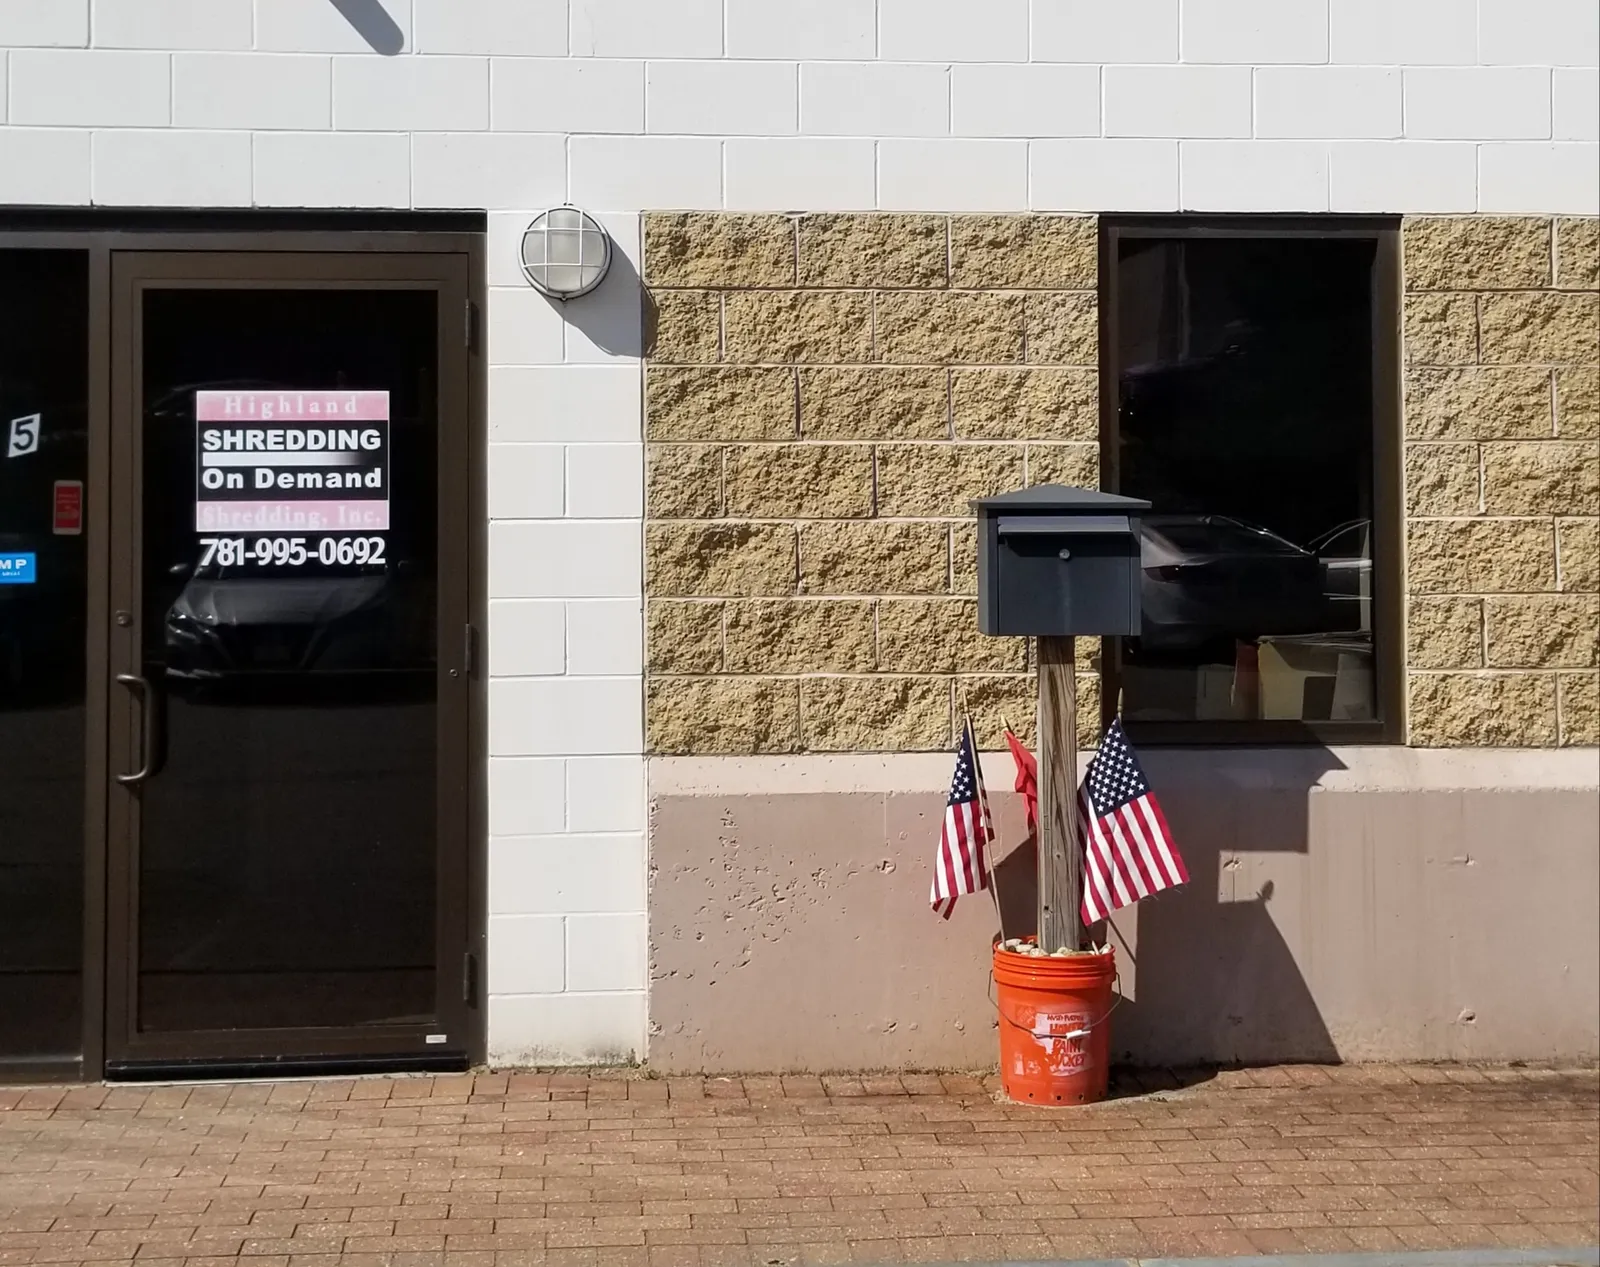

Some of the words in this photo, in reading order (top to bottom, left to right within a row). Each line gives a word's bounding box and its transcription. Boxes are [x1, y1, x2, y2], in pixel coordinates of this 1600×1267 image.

[224, 396, 357, 418] Highland
[13, 418, 34, 451] 5
[203, 429, 381, 450] SHREDDING
[202, 468, 244, 489] On
[255, 468, 381, 488] Demand
[203, 505, 327, 529] Shredding,
[338, 506, 381, 524] Inc.
[200, 537, 386, 566] 781-995-0692
